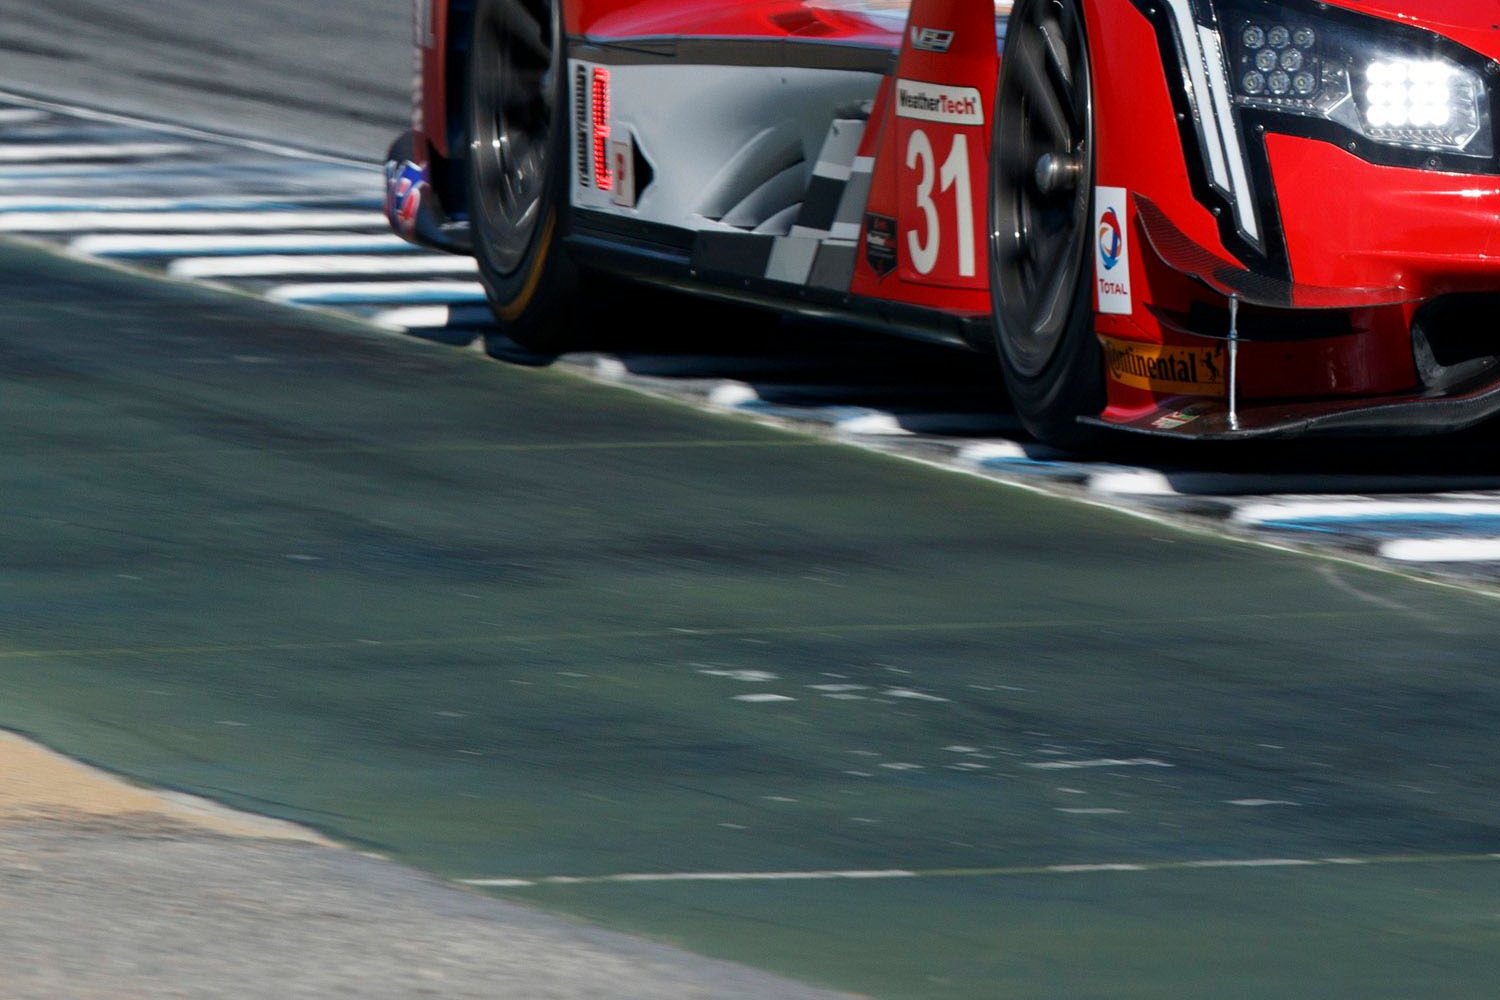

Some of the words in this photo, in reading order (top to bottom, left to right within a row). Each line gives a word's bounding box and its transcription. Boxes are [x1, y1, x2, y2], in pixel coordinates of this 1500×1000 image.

[900, 88, 975, 114] WeatherTech
[906, 128, 976, 277] 31
[1099, 278, 1128, 295] TOTAL
